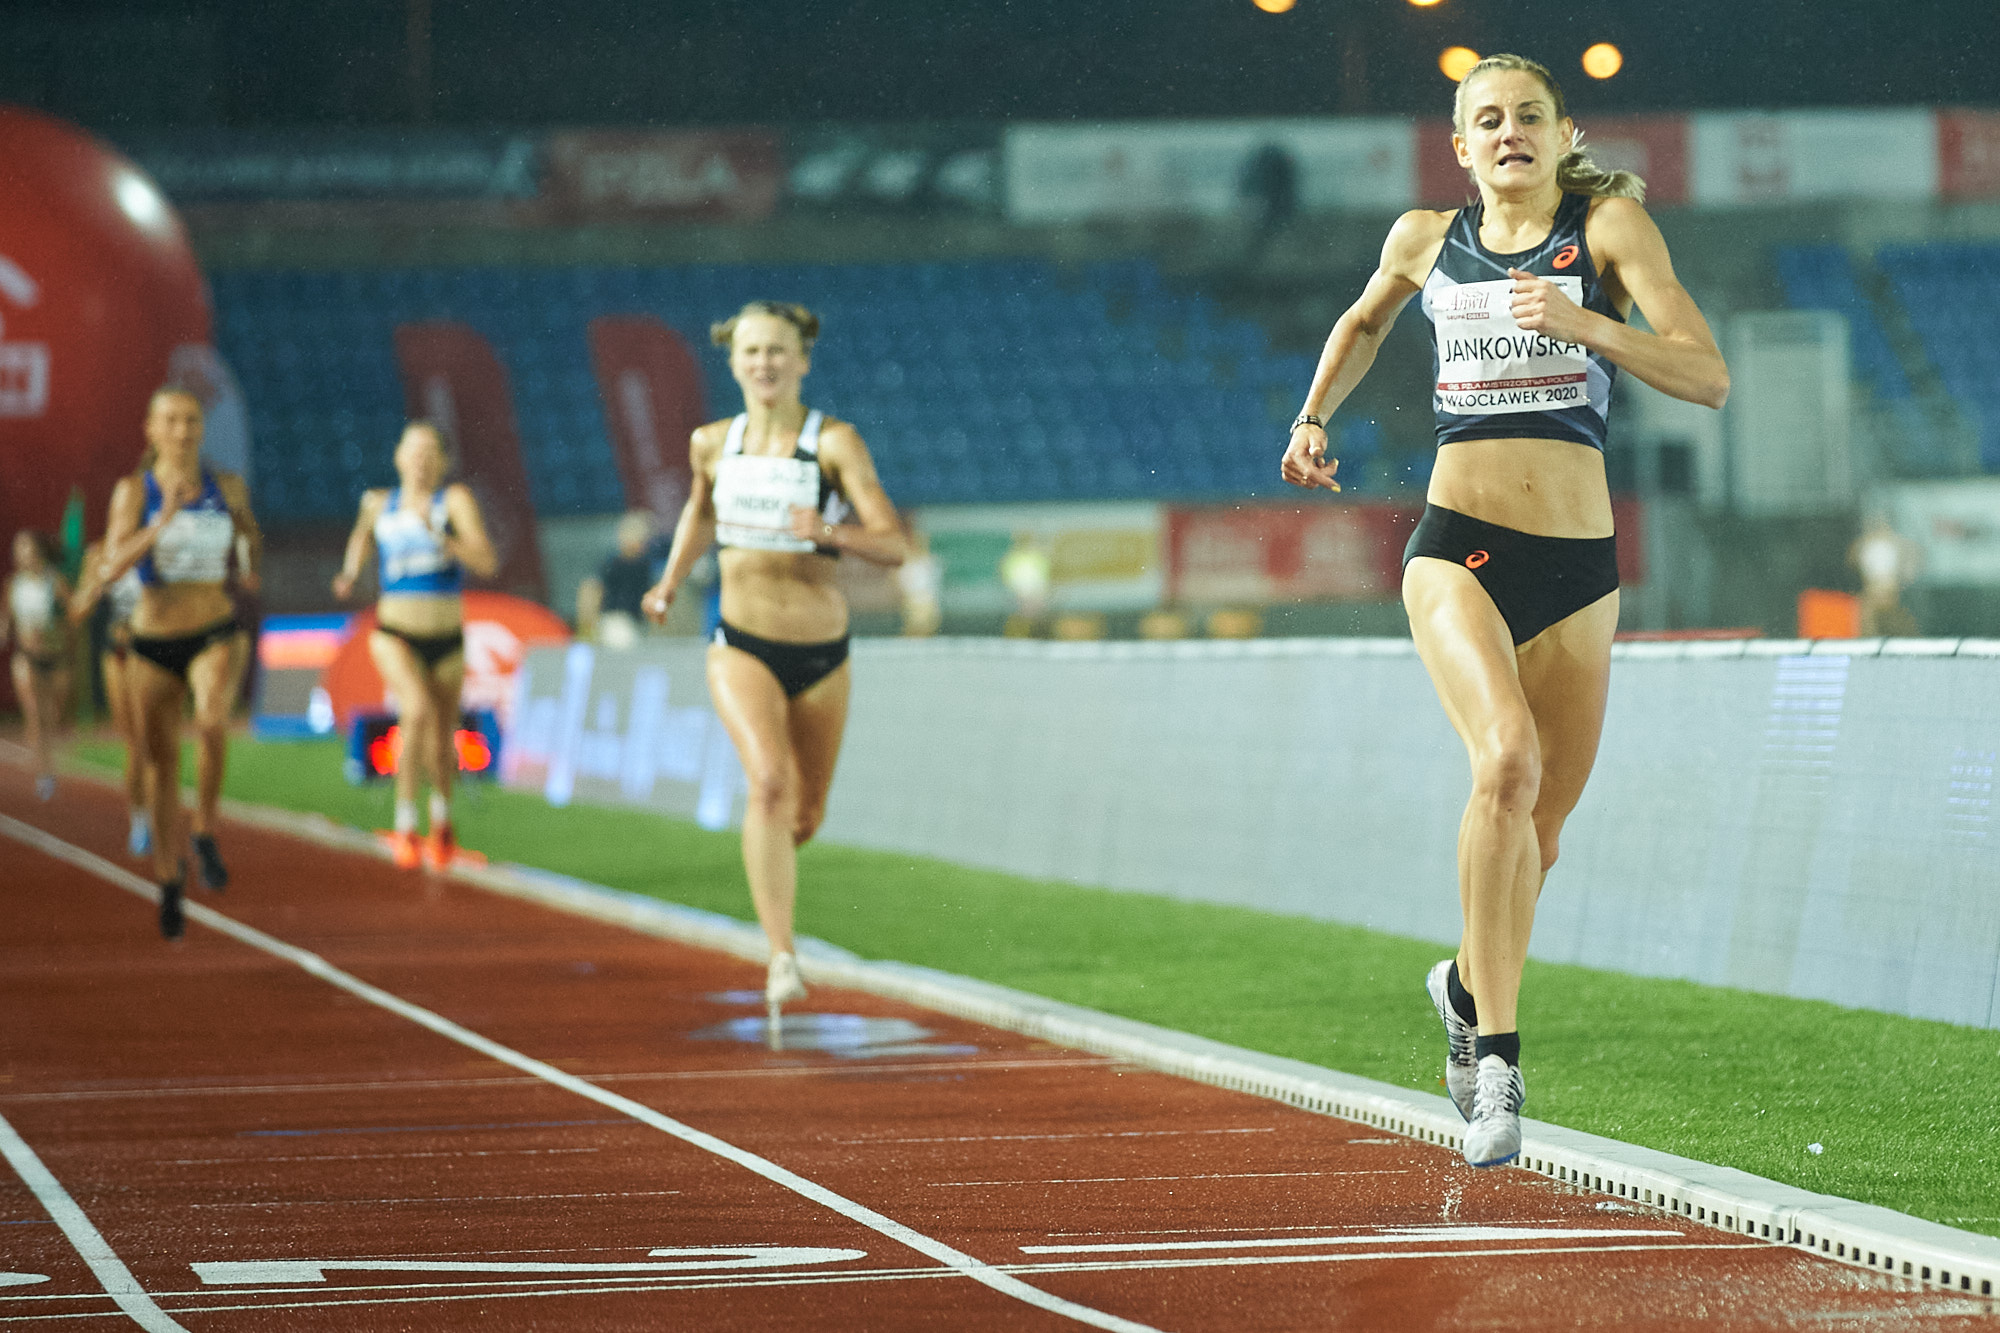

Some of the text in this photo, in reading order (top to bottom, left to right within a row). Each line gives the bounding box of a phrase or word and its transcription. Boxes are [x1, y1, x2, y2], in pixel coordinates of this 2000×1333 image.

[1445, 334, 1580, 363] JANKOWSKA
[1461, 382, 1481, 390] PZLA
[1482, 377, 1545, 388] MISTRZOSTWA
[1547, 374, 1577, 384] POLSKI
[1445, 386, 1578, 407] WŁOCŁAWEK 2020
